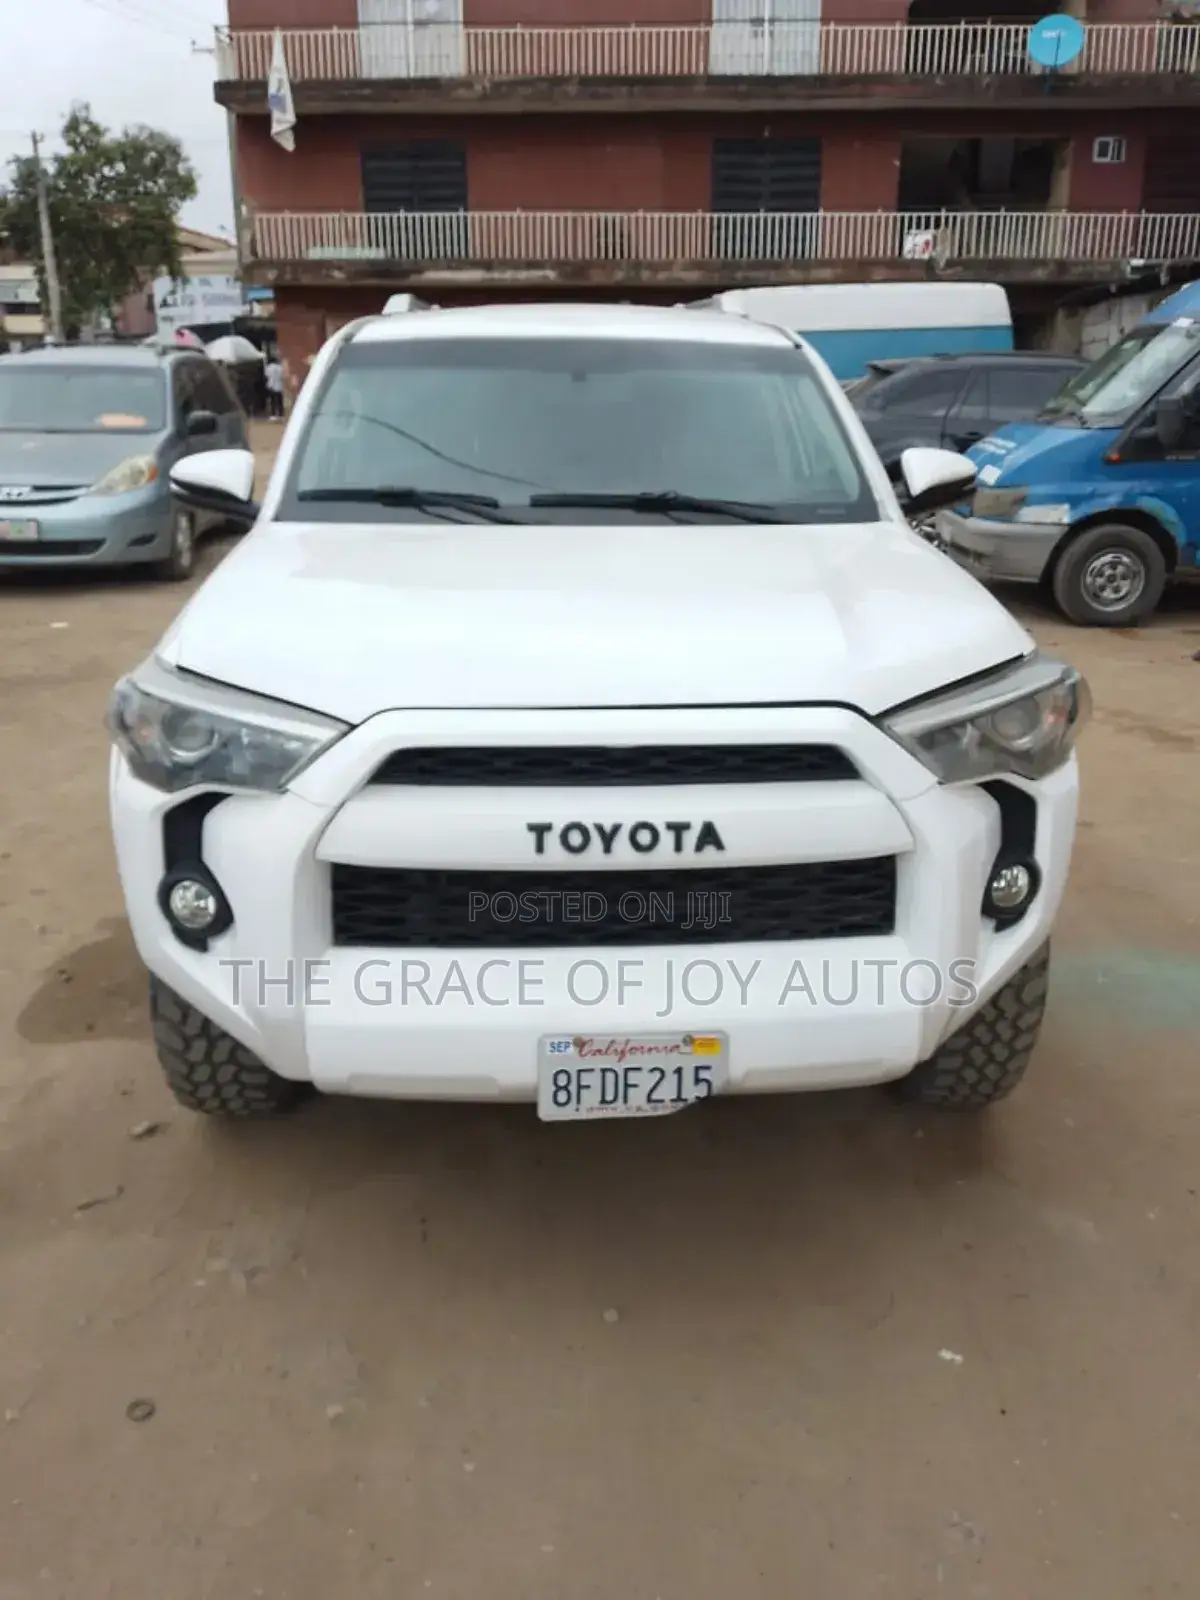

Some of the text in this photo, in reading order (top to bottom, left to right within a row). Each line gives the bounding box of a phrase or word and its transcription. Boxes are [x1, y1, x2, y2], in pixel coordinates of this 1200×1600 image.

[526, 820, 726, 855] TOYOTA
[549, 1040, 571, 1054] SEP
[578, 1037, 681, 1063] California
[552, 1064, 714, 1108] 8FDF215
